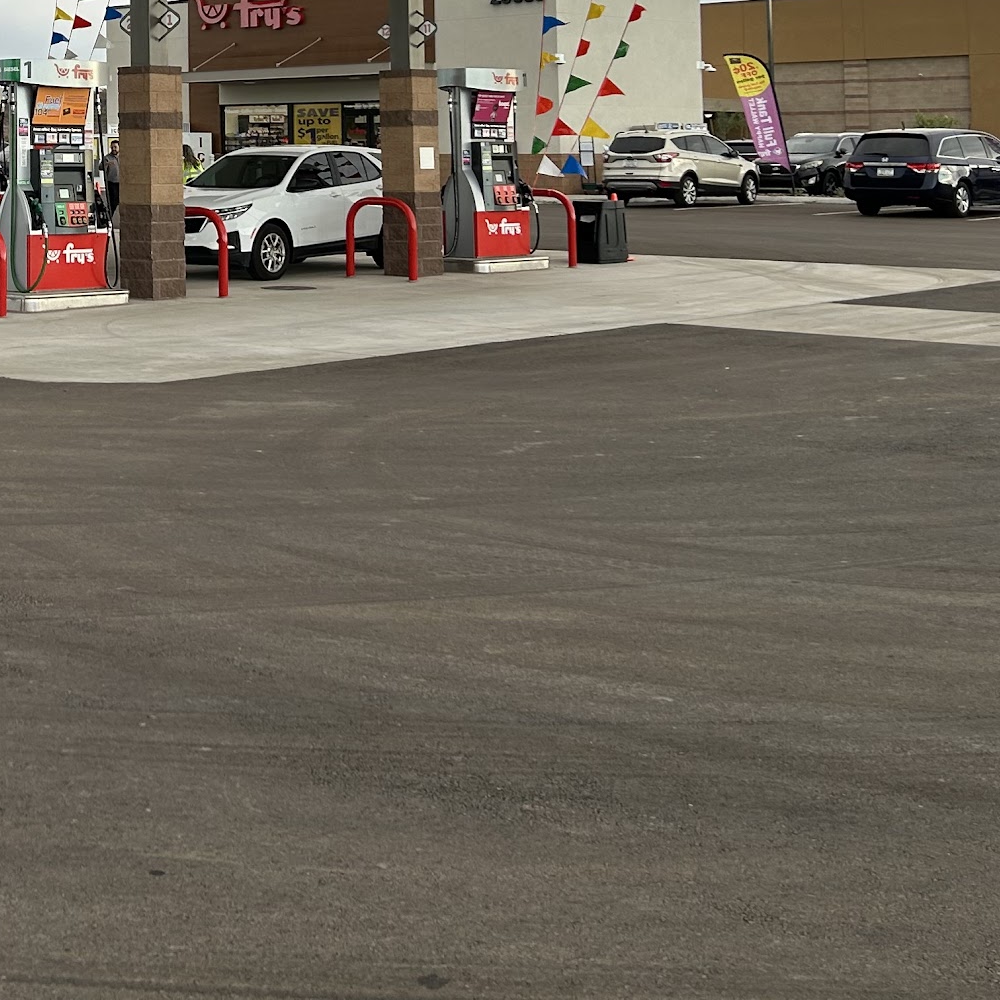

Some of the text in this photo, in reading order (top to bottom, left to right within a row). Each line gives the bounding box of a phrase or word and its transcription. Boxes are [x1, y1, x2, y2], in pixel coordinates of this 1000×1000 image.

[167, 14, 172, 25] 1
[424, 24, 431, 34] 11
[24, 61, 32, 78] 1
[297, 108, 340, 118] SAVE
[318, 117, 331, 125] to
[297, 128, 316, 144] $1
[316, 133, 339, 141] gallon
[499, 218, 521, 236] fry's
[63, 242, 95, 265] fry's
